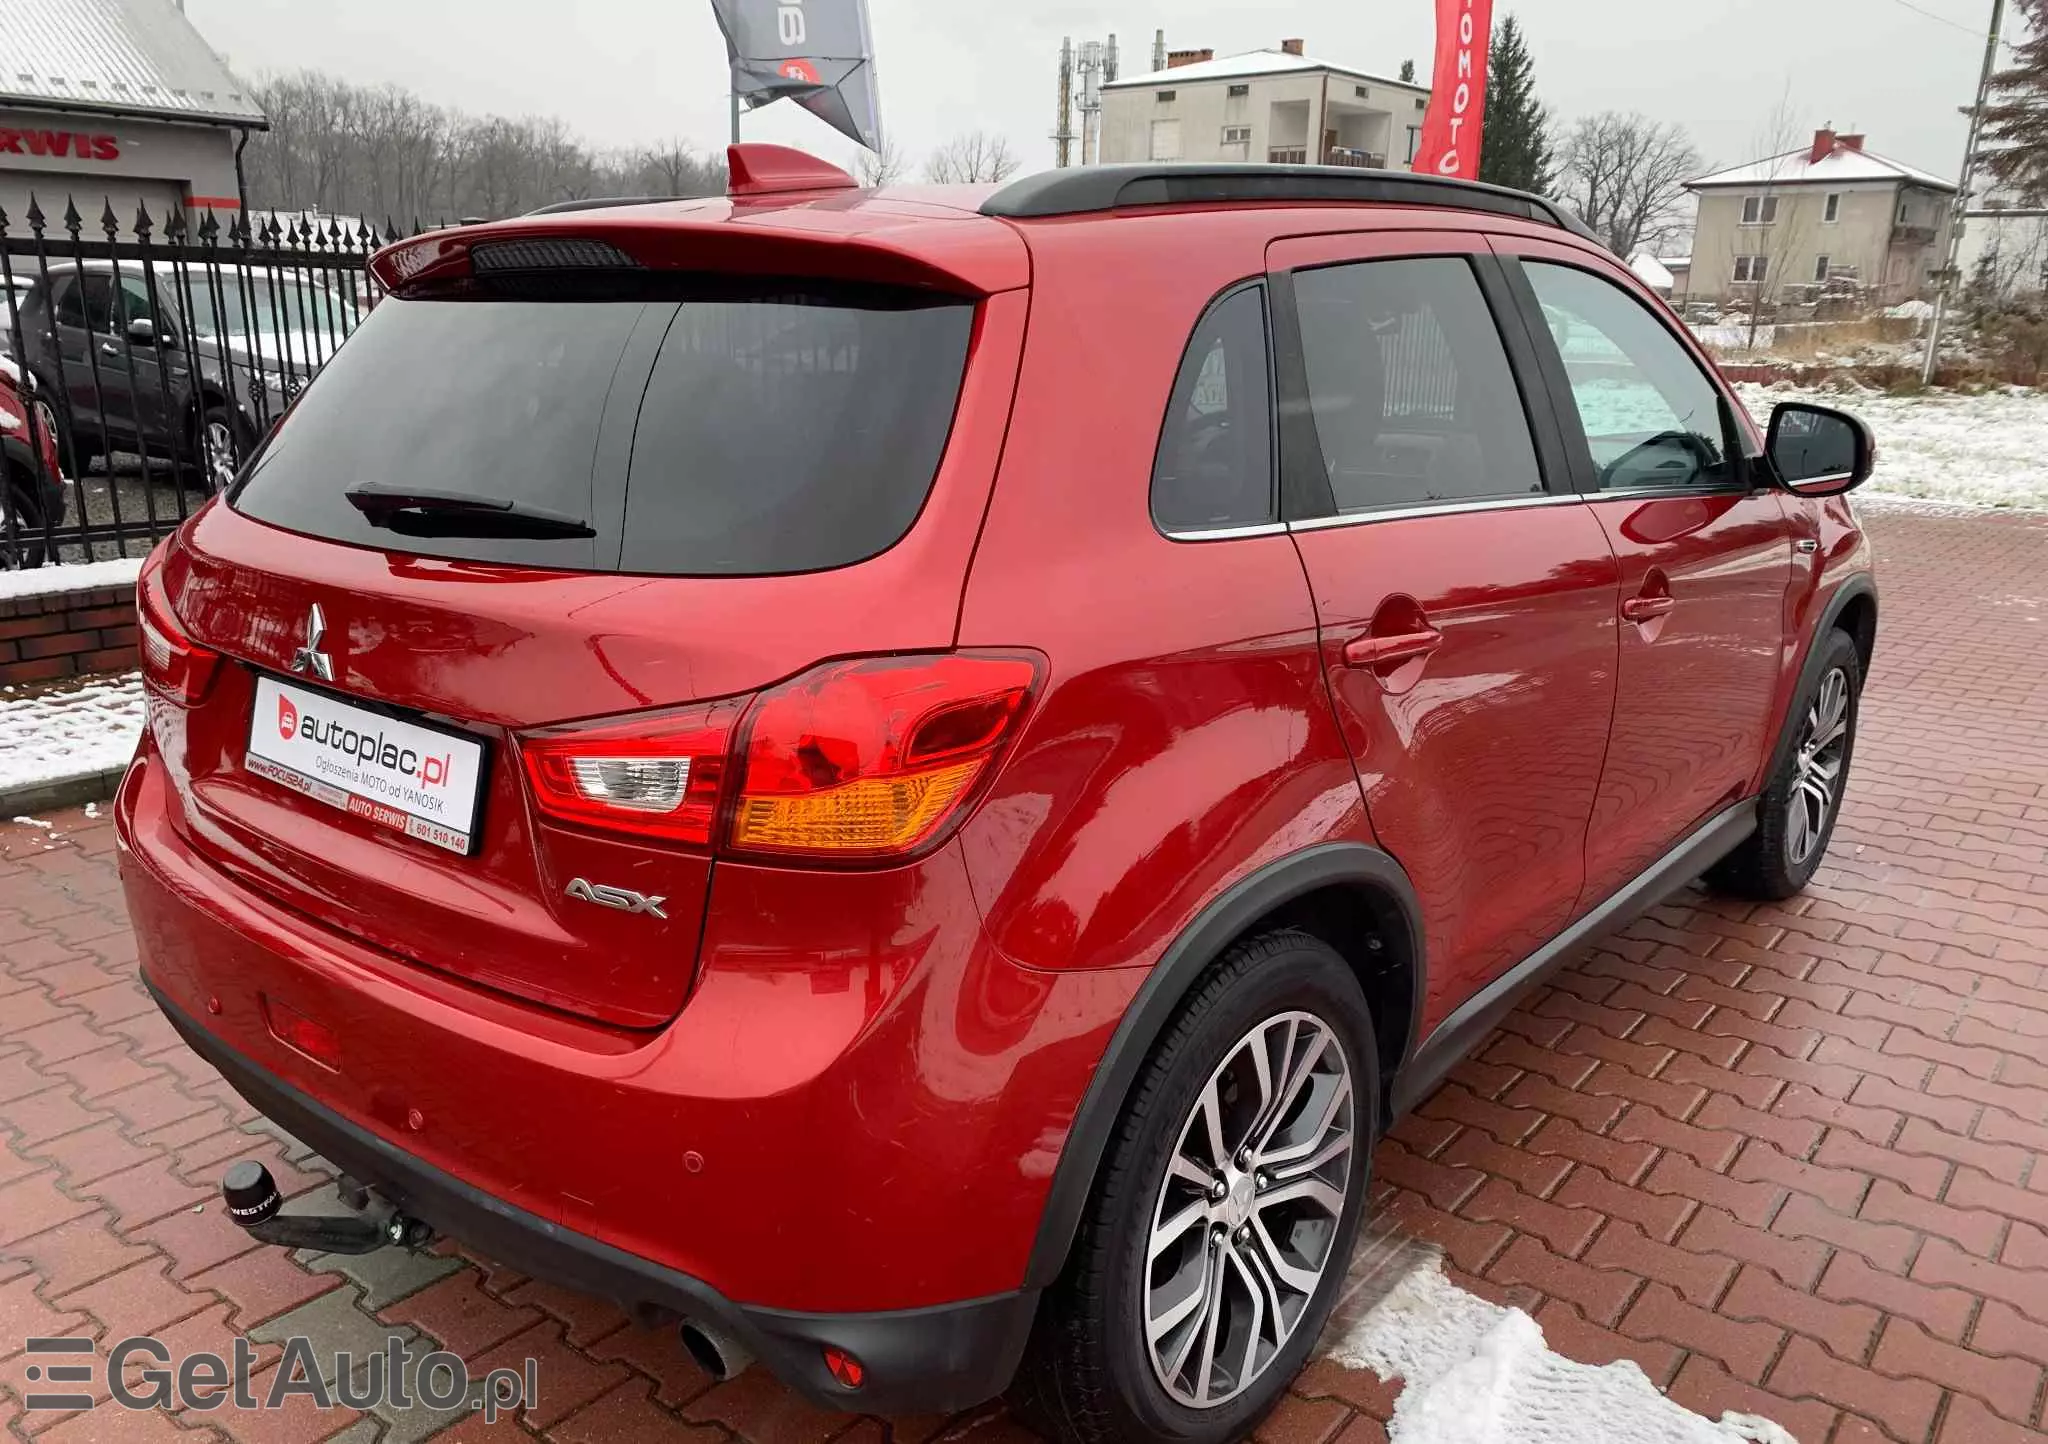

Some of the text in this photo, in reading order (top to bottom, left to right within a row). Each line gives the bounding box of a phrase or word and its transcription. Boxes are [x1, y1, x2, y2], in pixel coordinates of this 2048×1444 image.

[1438, 0, 1473, 175] OMOTO
[301, 714, 451, 789] autoplac.pl
[315, 755, 445, 815] Ogłoszenia MOTO od YANOSIK
[349, 797, 372, 817] AUTO
[373, 807, 407, 830] SERWIS
[564, 877, 668, 919] ASX
